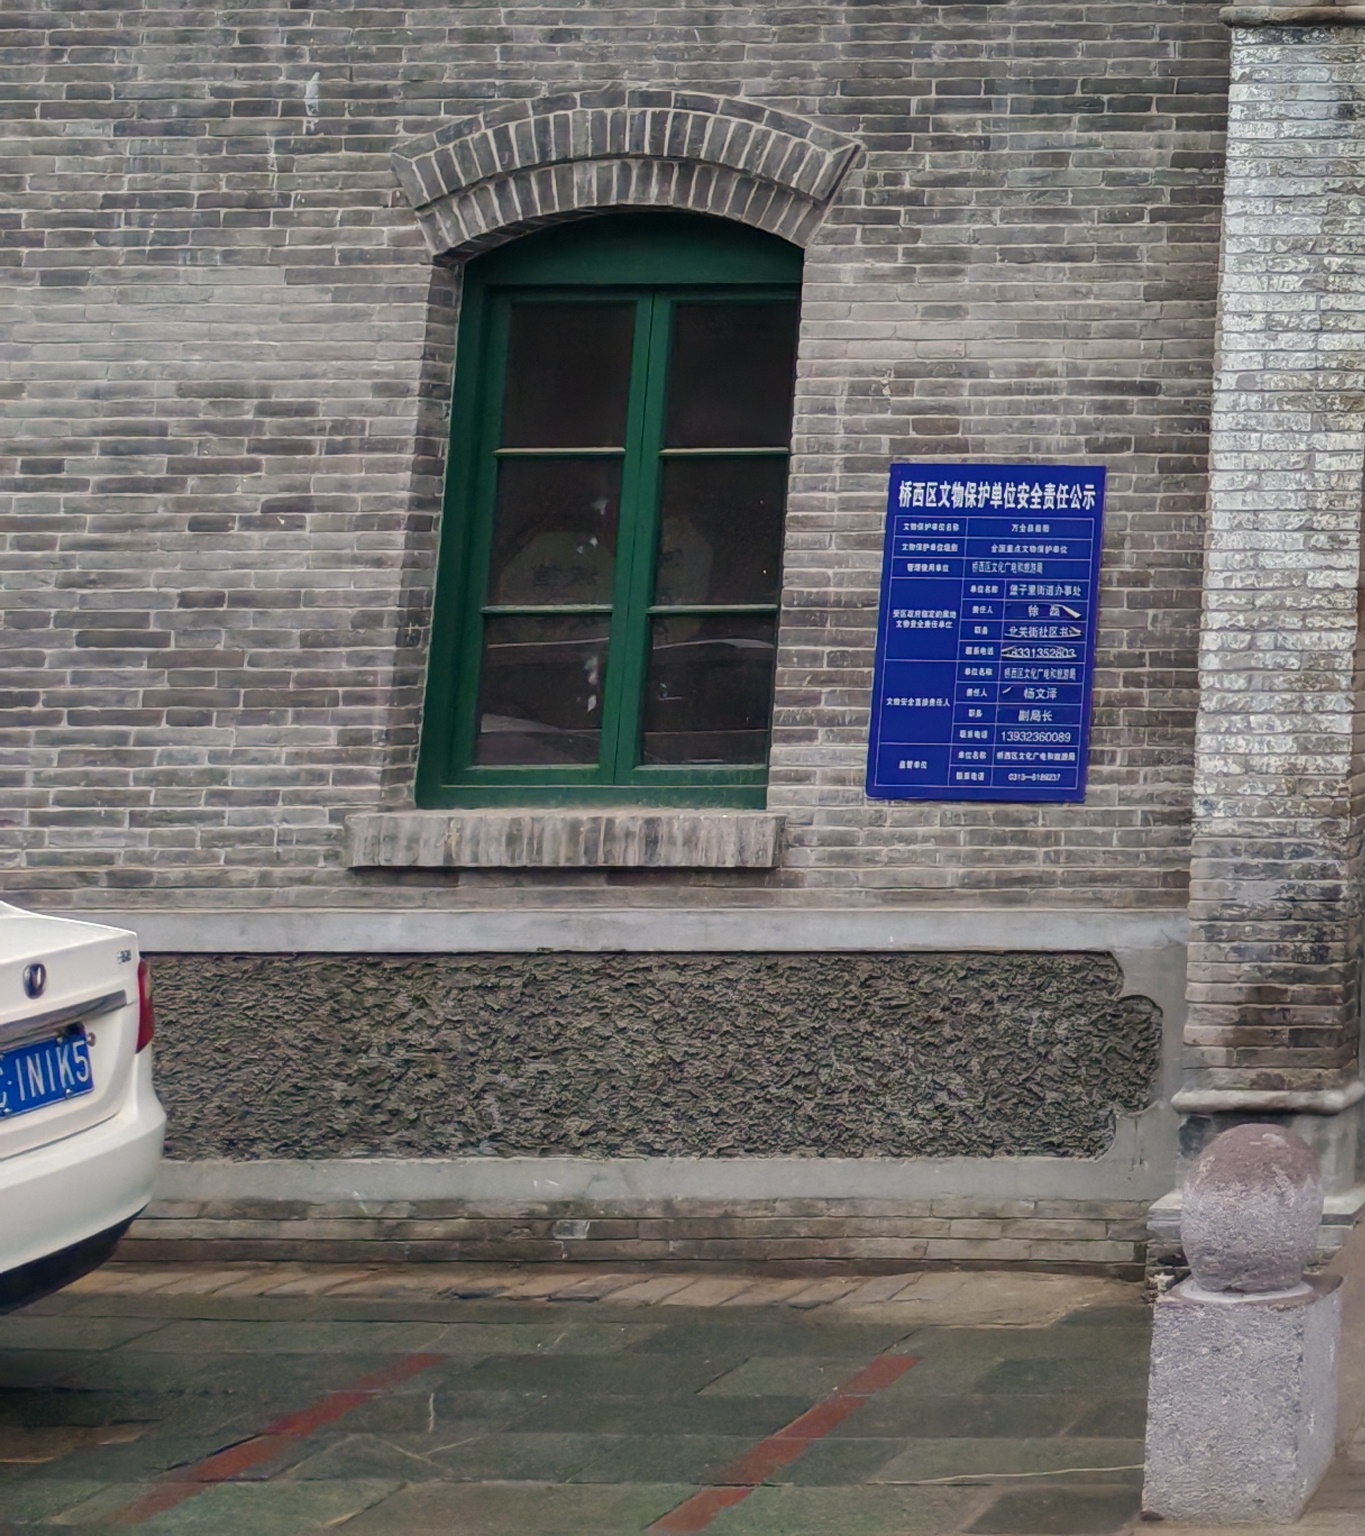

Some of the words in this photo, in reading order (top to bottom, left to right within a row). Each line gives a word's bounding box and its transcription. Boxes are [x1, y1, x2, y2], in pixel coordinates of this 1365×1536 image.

[899, 481, 1096, 510] 桥西区文物保护单位安全责任公示
[970, 585, 998, 593] 单位名称
[1009, 626, 1078, 638] 北关街社区书
[965, 668, 992, 676] 单位名称
[1018, 710, 1052, 721] 副局长
